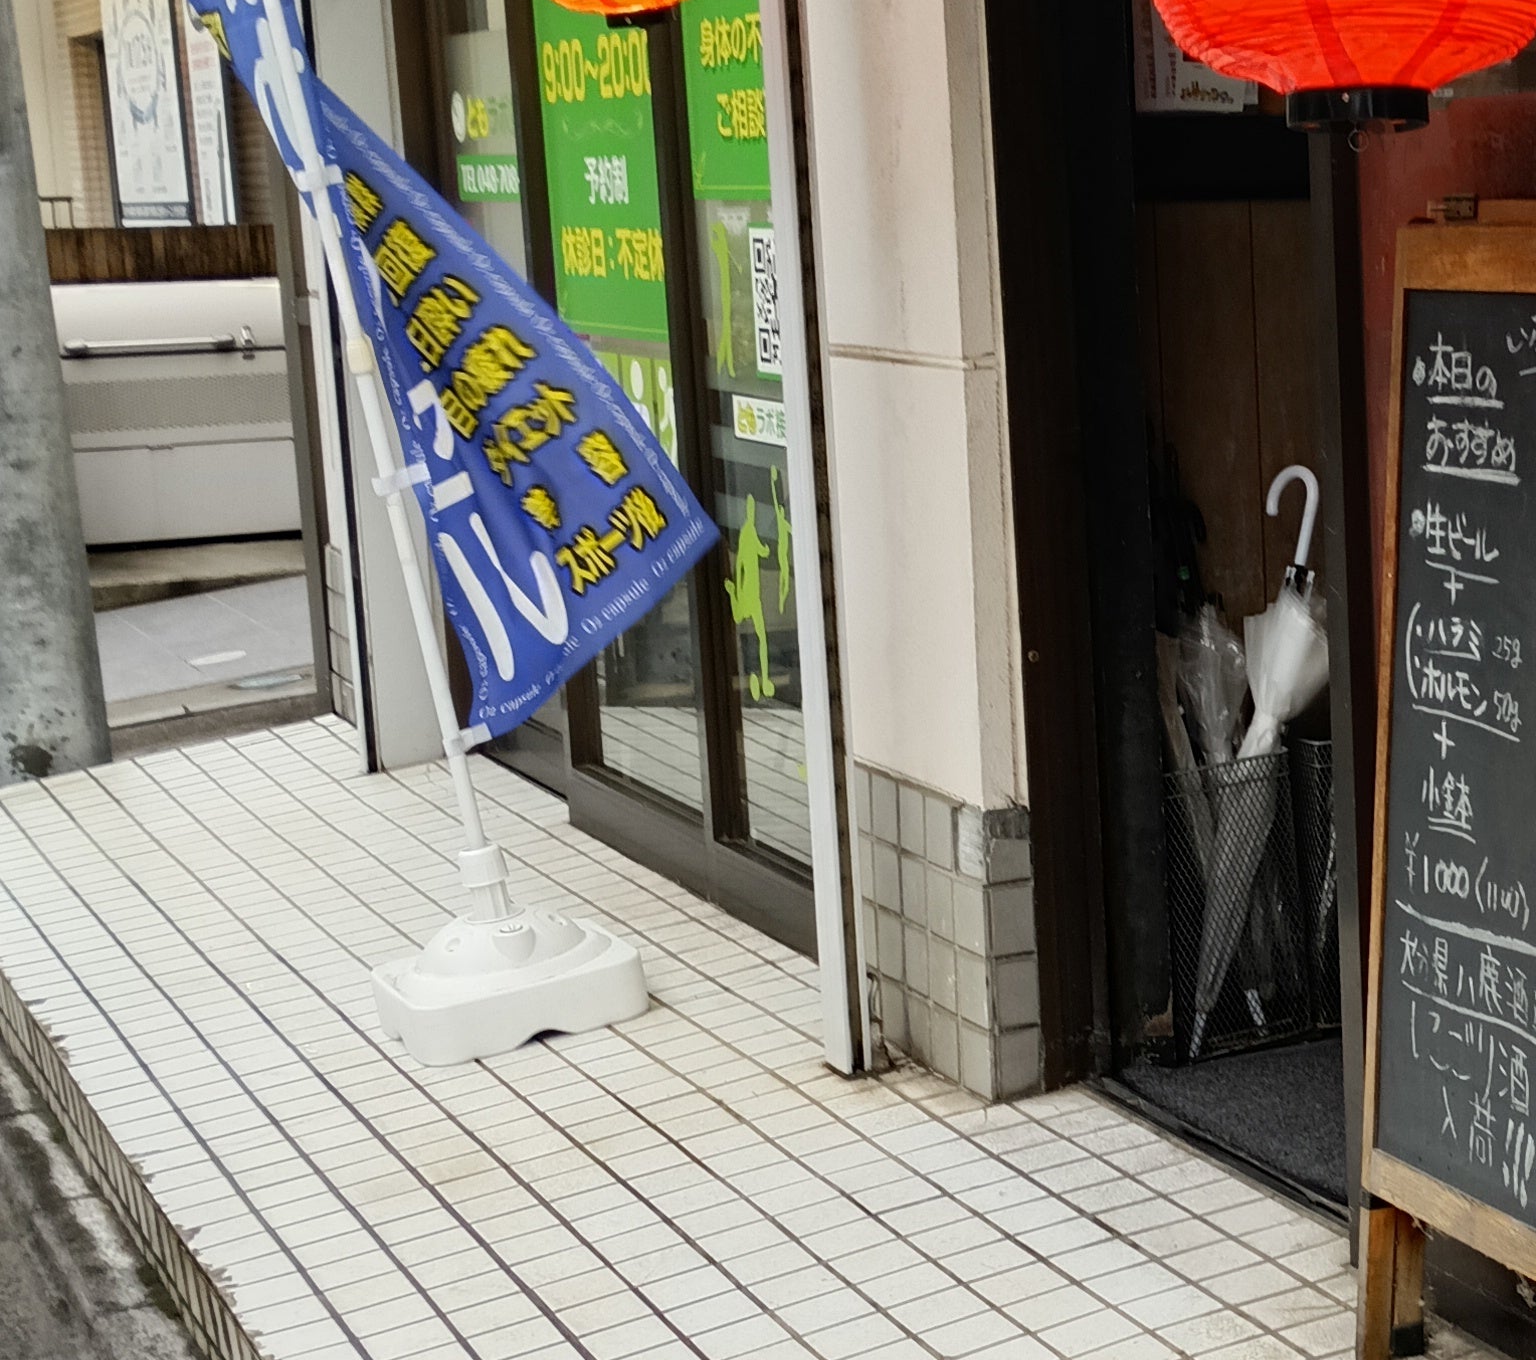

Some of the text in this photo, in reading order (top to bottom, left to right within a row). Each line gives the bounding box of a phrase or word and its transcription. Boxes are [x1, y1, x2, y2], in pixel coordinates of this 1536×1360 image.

[583, 155, 630, 205] 予約制
[1425, 415, 1517, 470] おすすめ
[554, 485, 669, 596] スポーツ後
[1424, 503, 1500, 563] 生ビール
